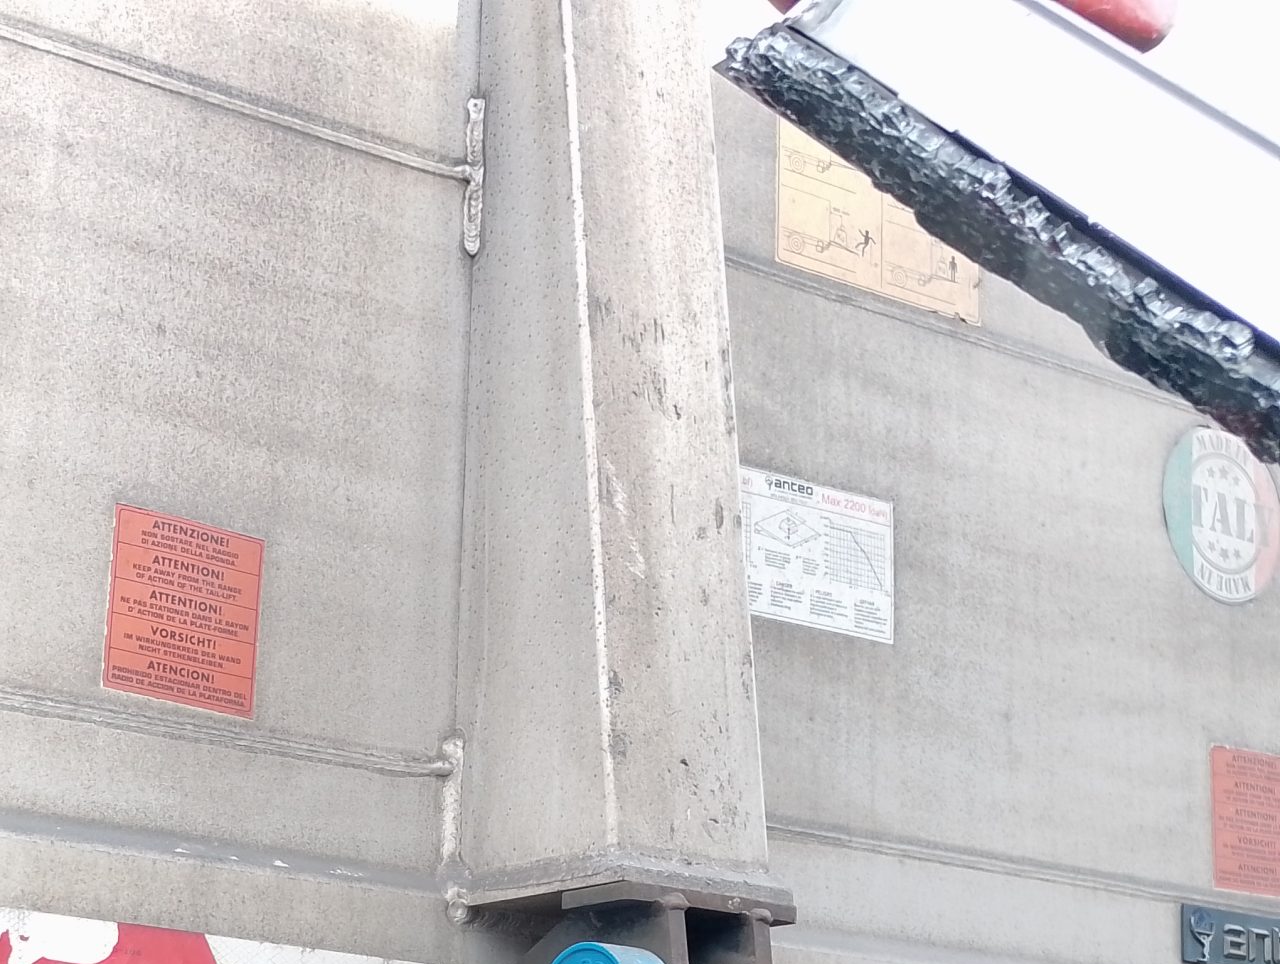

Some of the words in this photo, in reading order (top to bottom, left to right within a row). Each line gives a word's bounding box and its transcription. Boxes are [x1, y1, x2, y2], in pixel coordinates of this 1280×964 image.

[774, 478, 814, 496] anteo
[821, 493, 840, 507] Max
[843, 500, 866, 514] 2200
[142, 530, 157, 539] NON
[196, 543, 209, 552] NEL
[153, 520, 230, 548] ATTENZIONE!
[151, 541, 177, 552] AZIONE
[181, 547, 203, 558] DELLA
[133, 563, 151, 572] KEEP
[154, 568, 175, 578] AWAY
[178, 573, 199, 584] FROM
[202, 579, 215, 588] THE
[152, 555, 225, 581] ATTENTION!
[148, 575, 174, 586] ACTION
[190, 584, 203, 593] THE
[133, 599, 147, 607] PAS
[192, 613, 212, 623] DANS
[225, 621, 249, 631] RAYON
[150, 590, 222, 616] ATTENTION!
[137, 609, 164, 620] ACTION
[167, 615, 176, 623] DE
[139, 644, 161, 654] NICHT
[151, 626, 217, 650] VORSICHT!
[202, 651, 216, 659] DER
[219, 654, 241, 664] WAND
[112, 665, 152, 679] PROHIBIDO
[155, 675, 200, 690] ESTACIONAR
[203, 685, 231, 696] DENTRO
[234, 691, 247, 700] DEL
[112, 673, 133, 683] RADIO
[136, 678, 145, 686] DE
[148, 681, 174, 692] ACCION
[148, 660, 215, 684] ATENCION!
